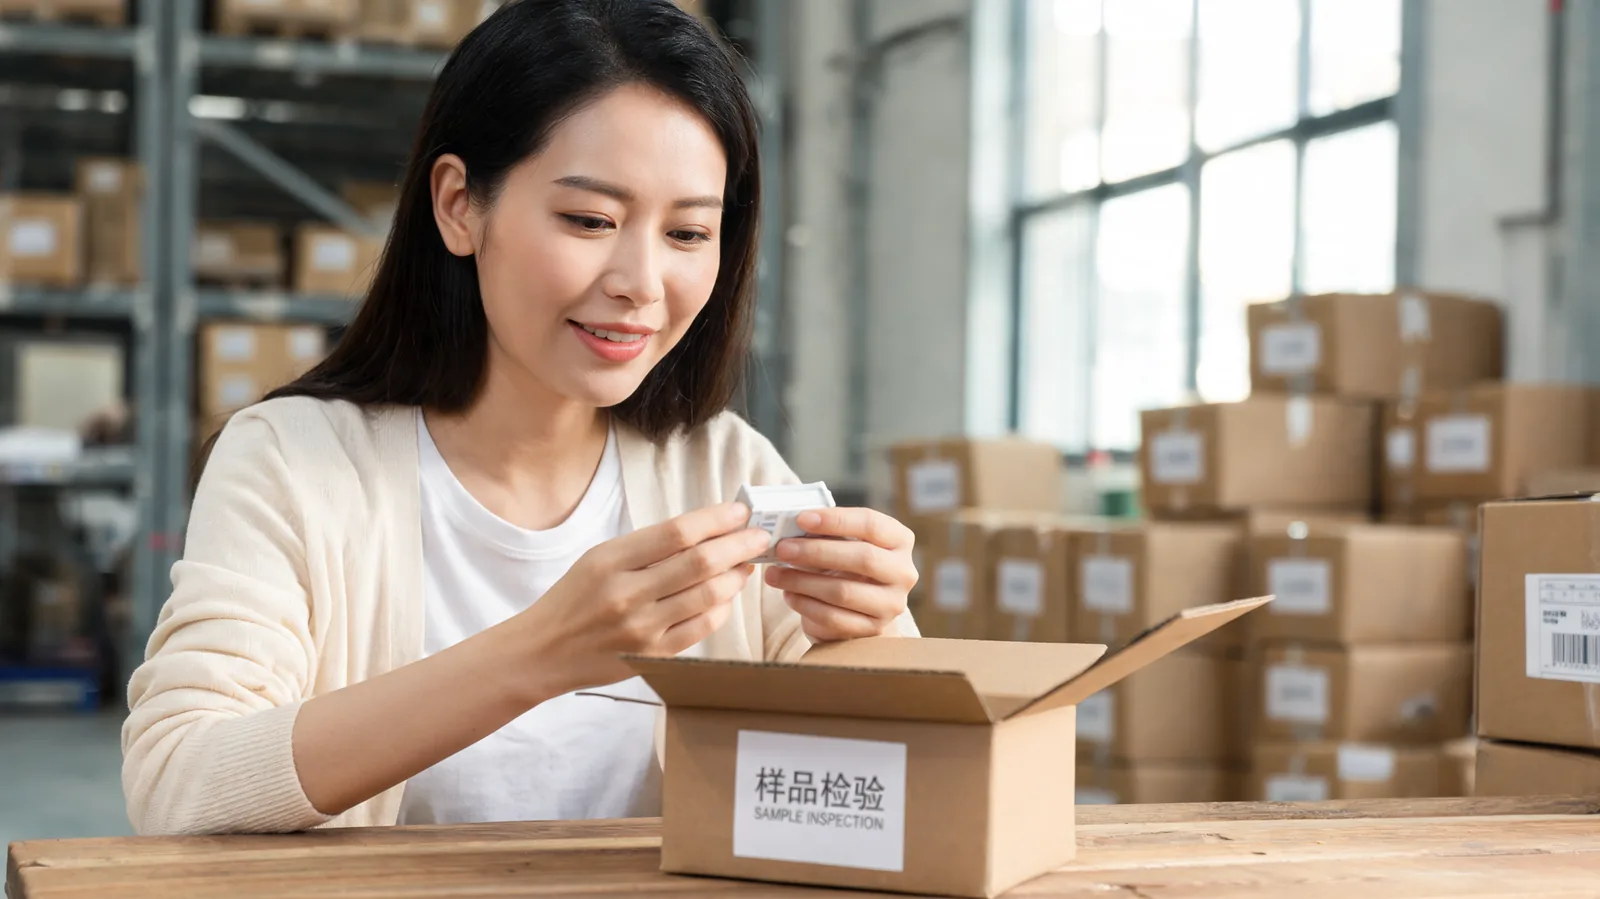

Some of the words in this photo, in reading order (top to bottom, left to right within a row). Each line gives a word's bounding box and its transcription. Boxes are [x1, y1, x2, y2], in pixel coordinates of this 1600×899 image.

[755, 766, 885, 811] 样品检验
[754, 806, 803, 824] SAMPLE
[807, 810, 884, 830] INSPECTION
